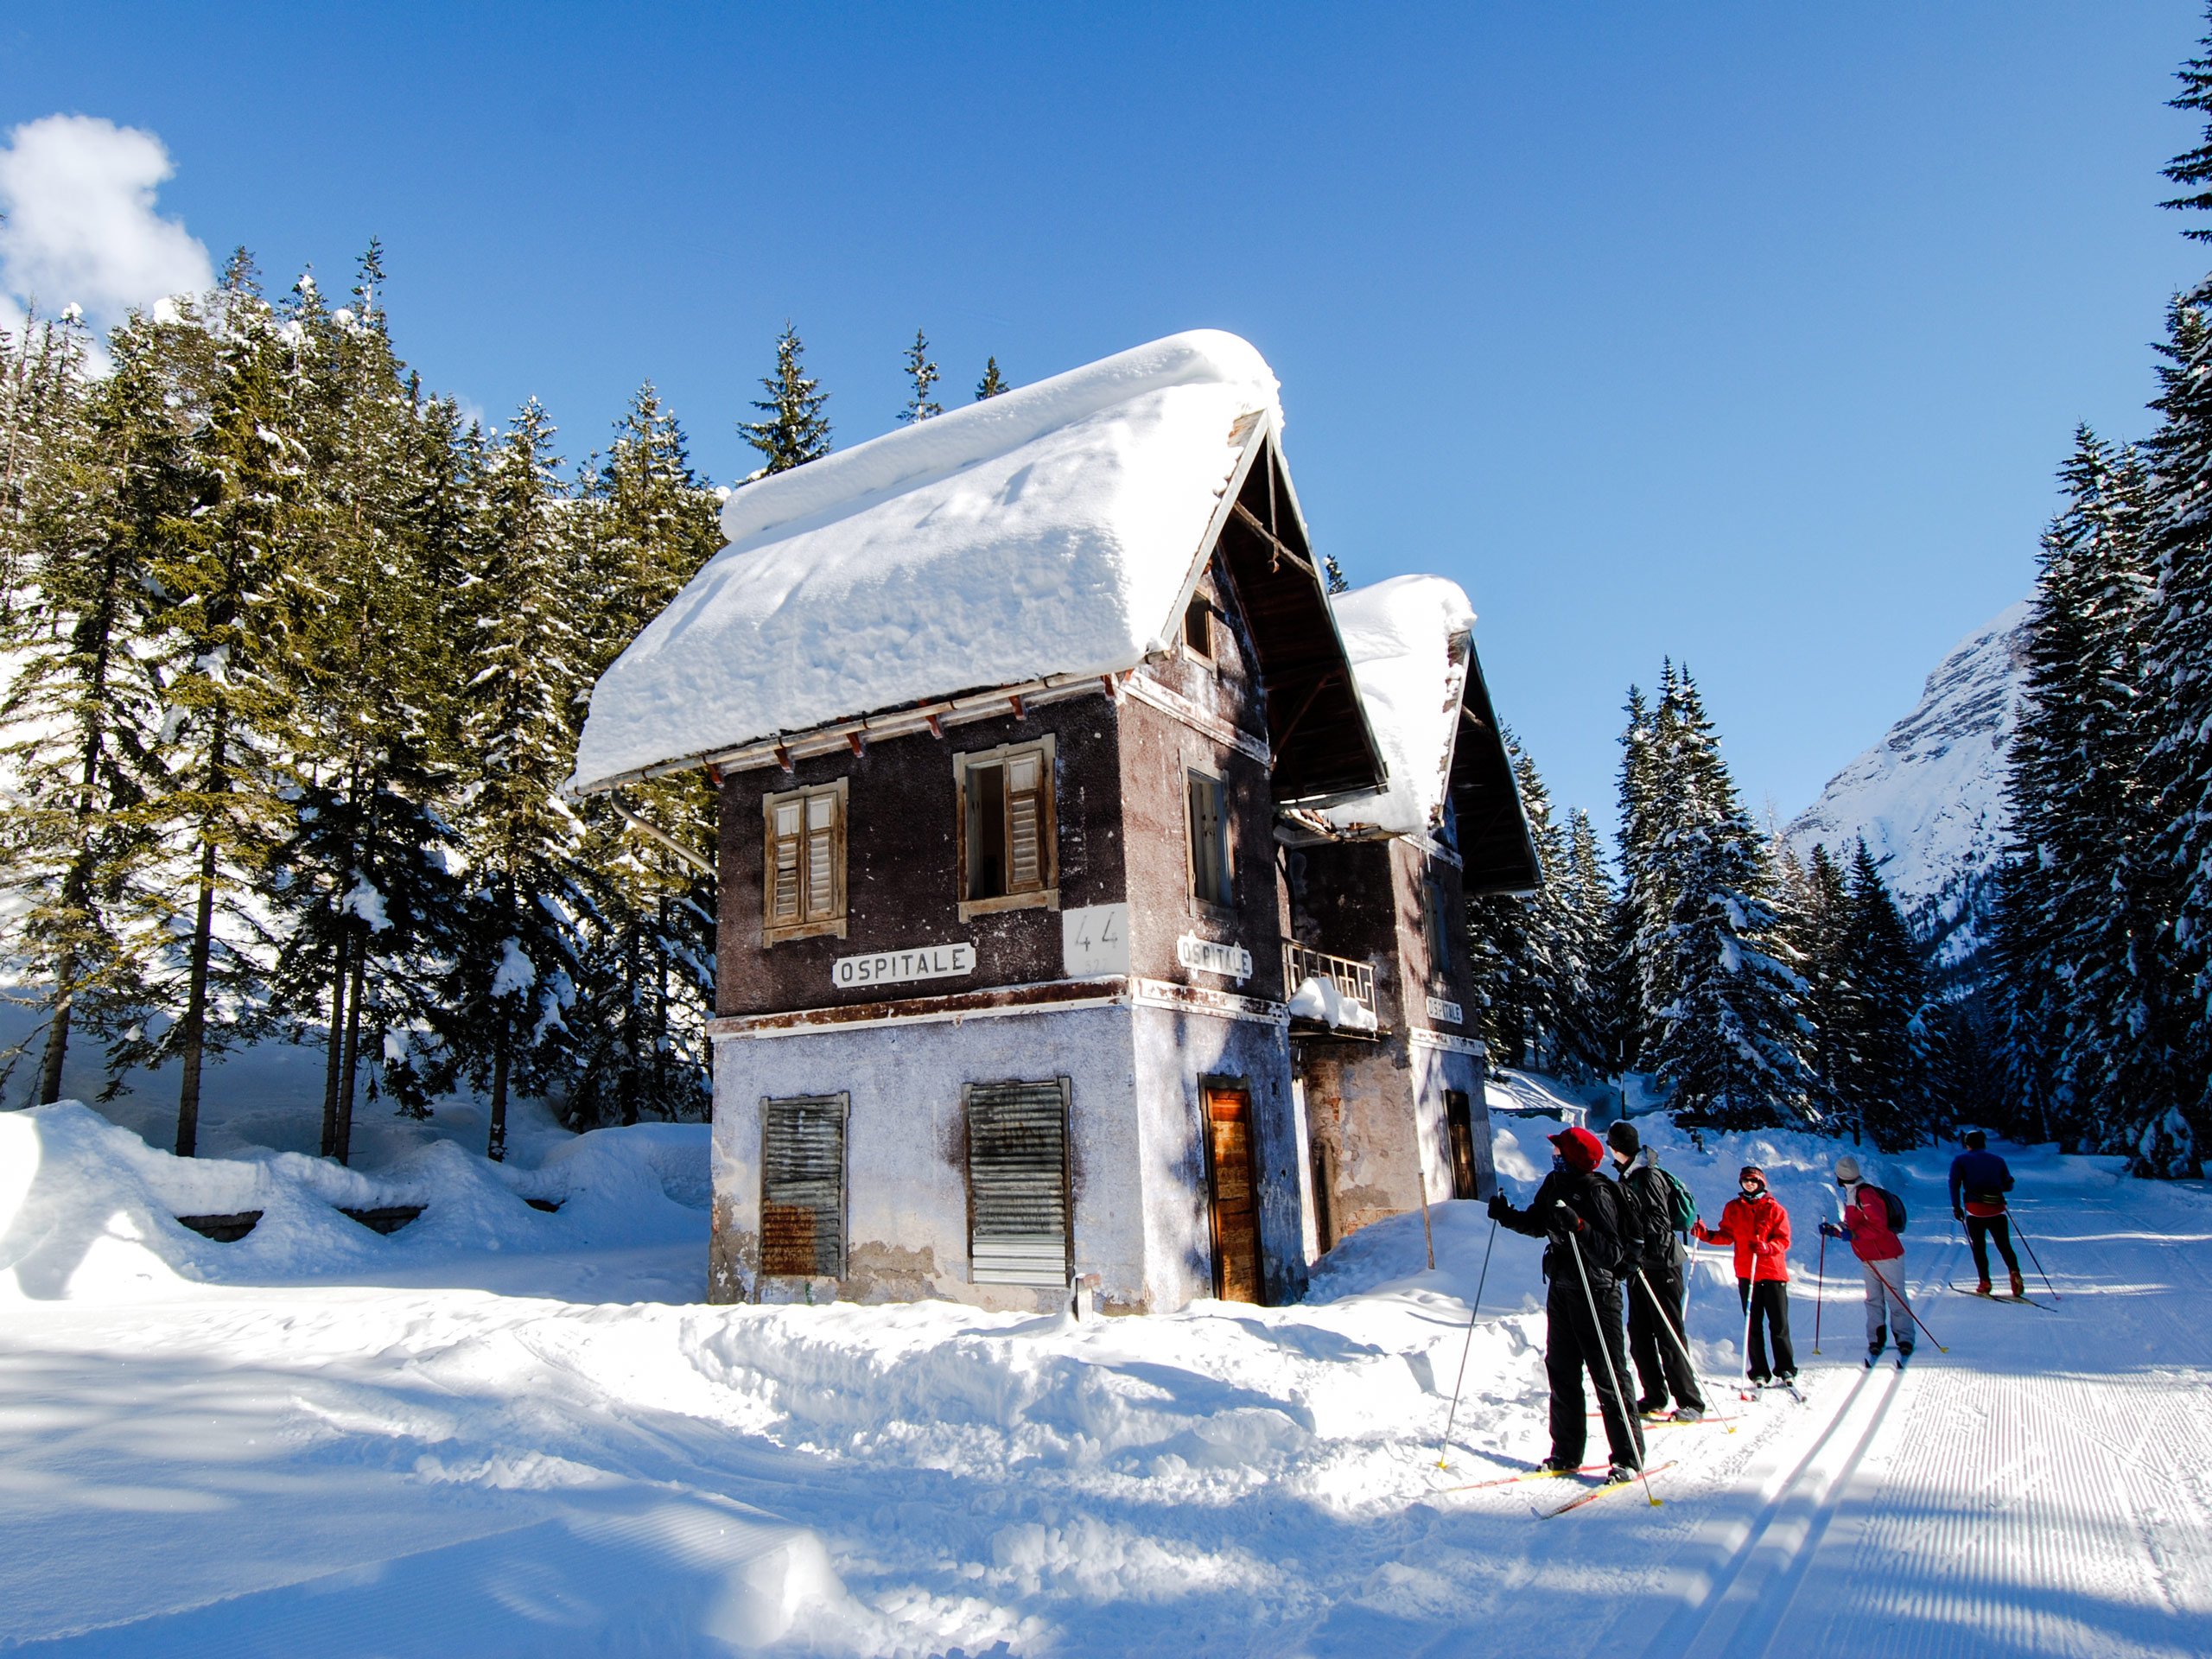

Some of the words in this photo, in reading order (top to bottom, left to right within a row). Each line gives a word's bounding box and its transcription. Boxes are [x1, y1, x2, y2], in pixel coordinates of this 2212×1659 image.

[1075, 911, 1118, 951] 44
[841, 948, 966, 982] OSPITALE
[1183, 943, 1249, 975] OSPITALE
[1428, 999, 1461, 1021] OSPITALE
